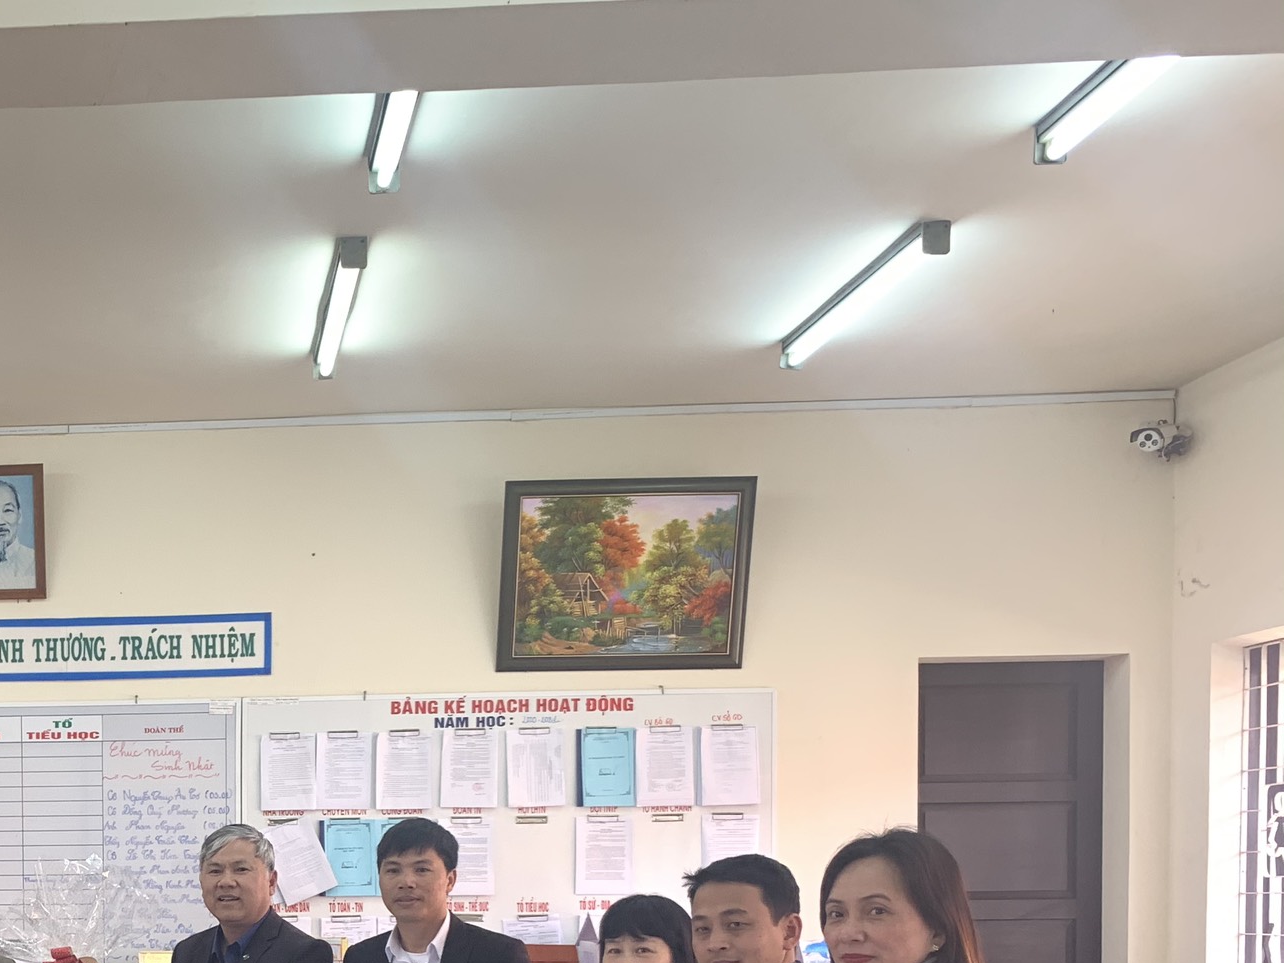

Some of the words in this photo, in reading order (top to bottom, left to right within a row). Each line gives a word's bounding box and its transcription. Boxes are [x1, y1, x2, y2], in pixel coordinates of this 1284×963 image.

[119, 628, 182, 661] TRÁCH
[191, 626, 256, 663] NHIỆM
[390, 697, 438, 715] BẢNG
[444, 695, 467, 714] KẾ
[472, 699, 529, 716] HOẠCH
[536, 698, 581, 714] HOẠT
[585, 696, 634, 716] ĐỘNG
[52, 717, 74, 729] TỔ
[434, 713, 469, 729] NĂM
[26, 729, 62, 740] TIỂU
[66, 731, 100, 742] HỌC
[144, 726, 167, 734] ĐOÀN
[168, 724, 185, 734] THỂ
[150, 760, 183, 772] Sinh
